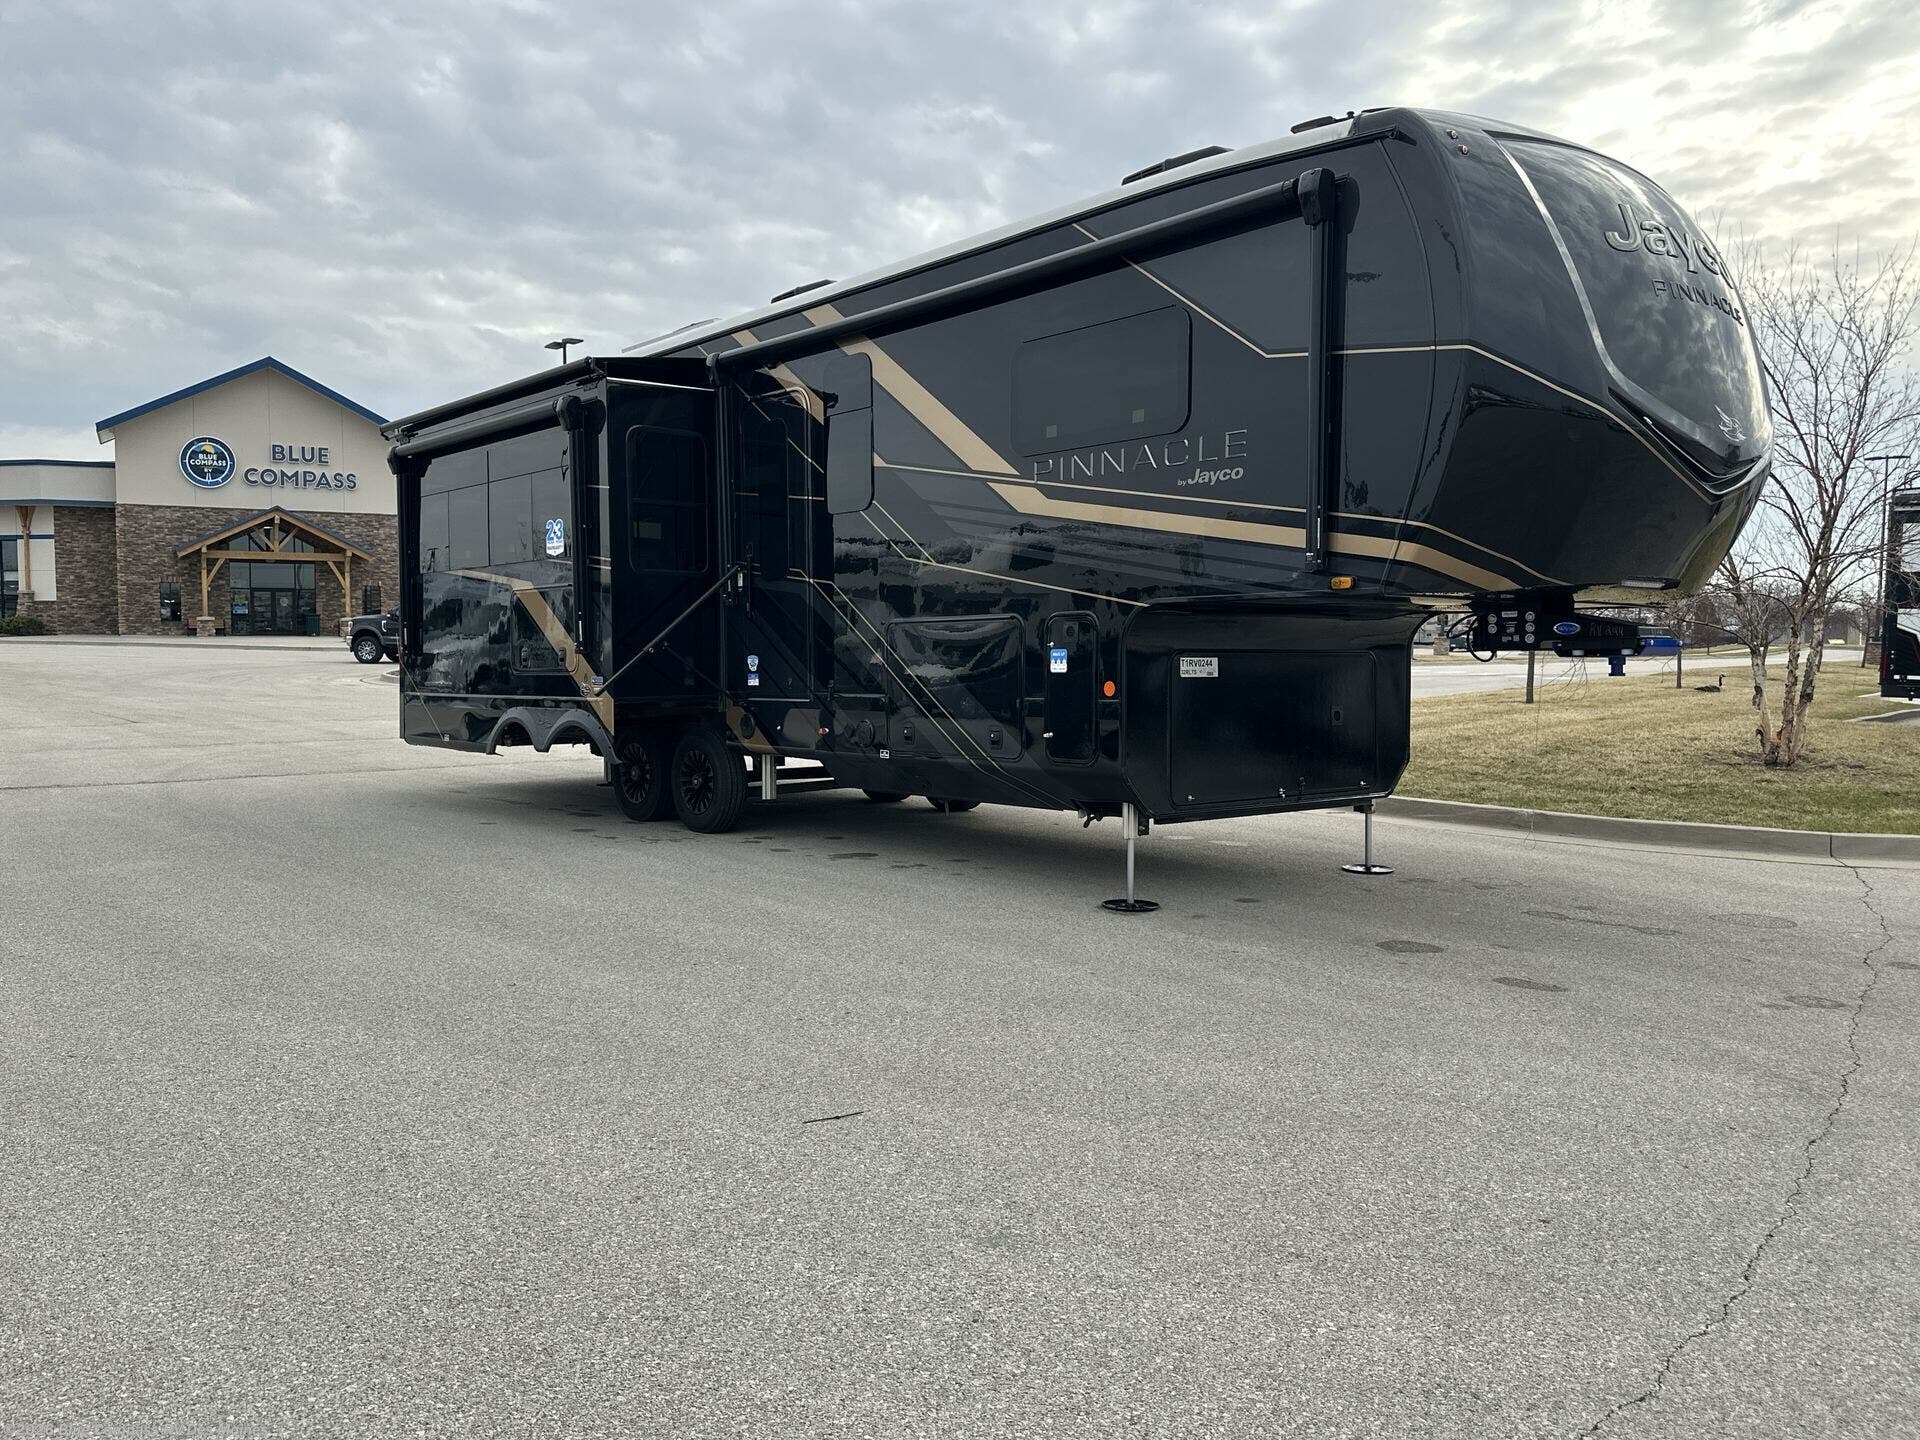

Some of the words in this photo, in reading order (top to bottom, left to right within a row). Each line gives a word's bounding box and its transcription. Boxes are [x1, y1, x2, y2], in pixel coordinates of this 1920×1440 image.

[1651, 279, 1744, 327] PINNACLE
[189, 458, 227, 467] COMPASS
[271, 443, 330, 465] BLUE
[1033, 429, 1248, 483] PINNACLE
[243, 467, 358, 490] COMPASS
[1177, 479, 1188, 487] by
[1187, 466, 1245, 486] Jayco
[1181, 659, 1213, 668] T1RV0244
